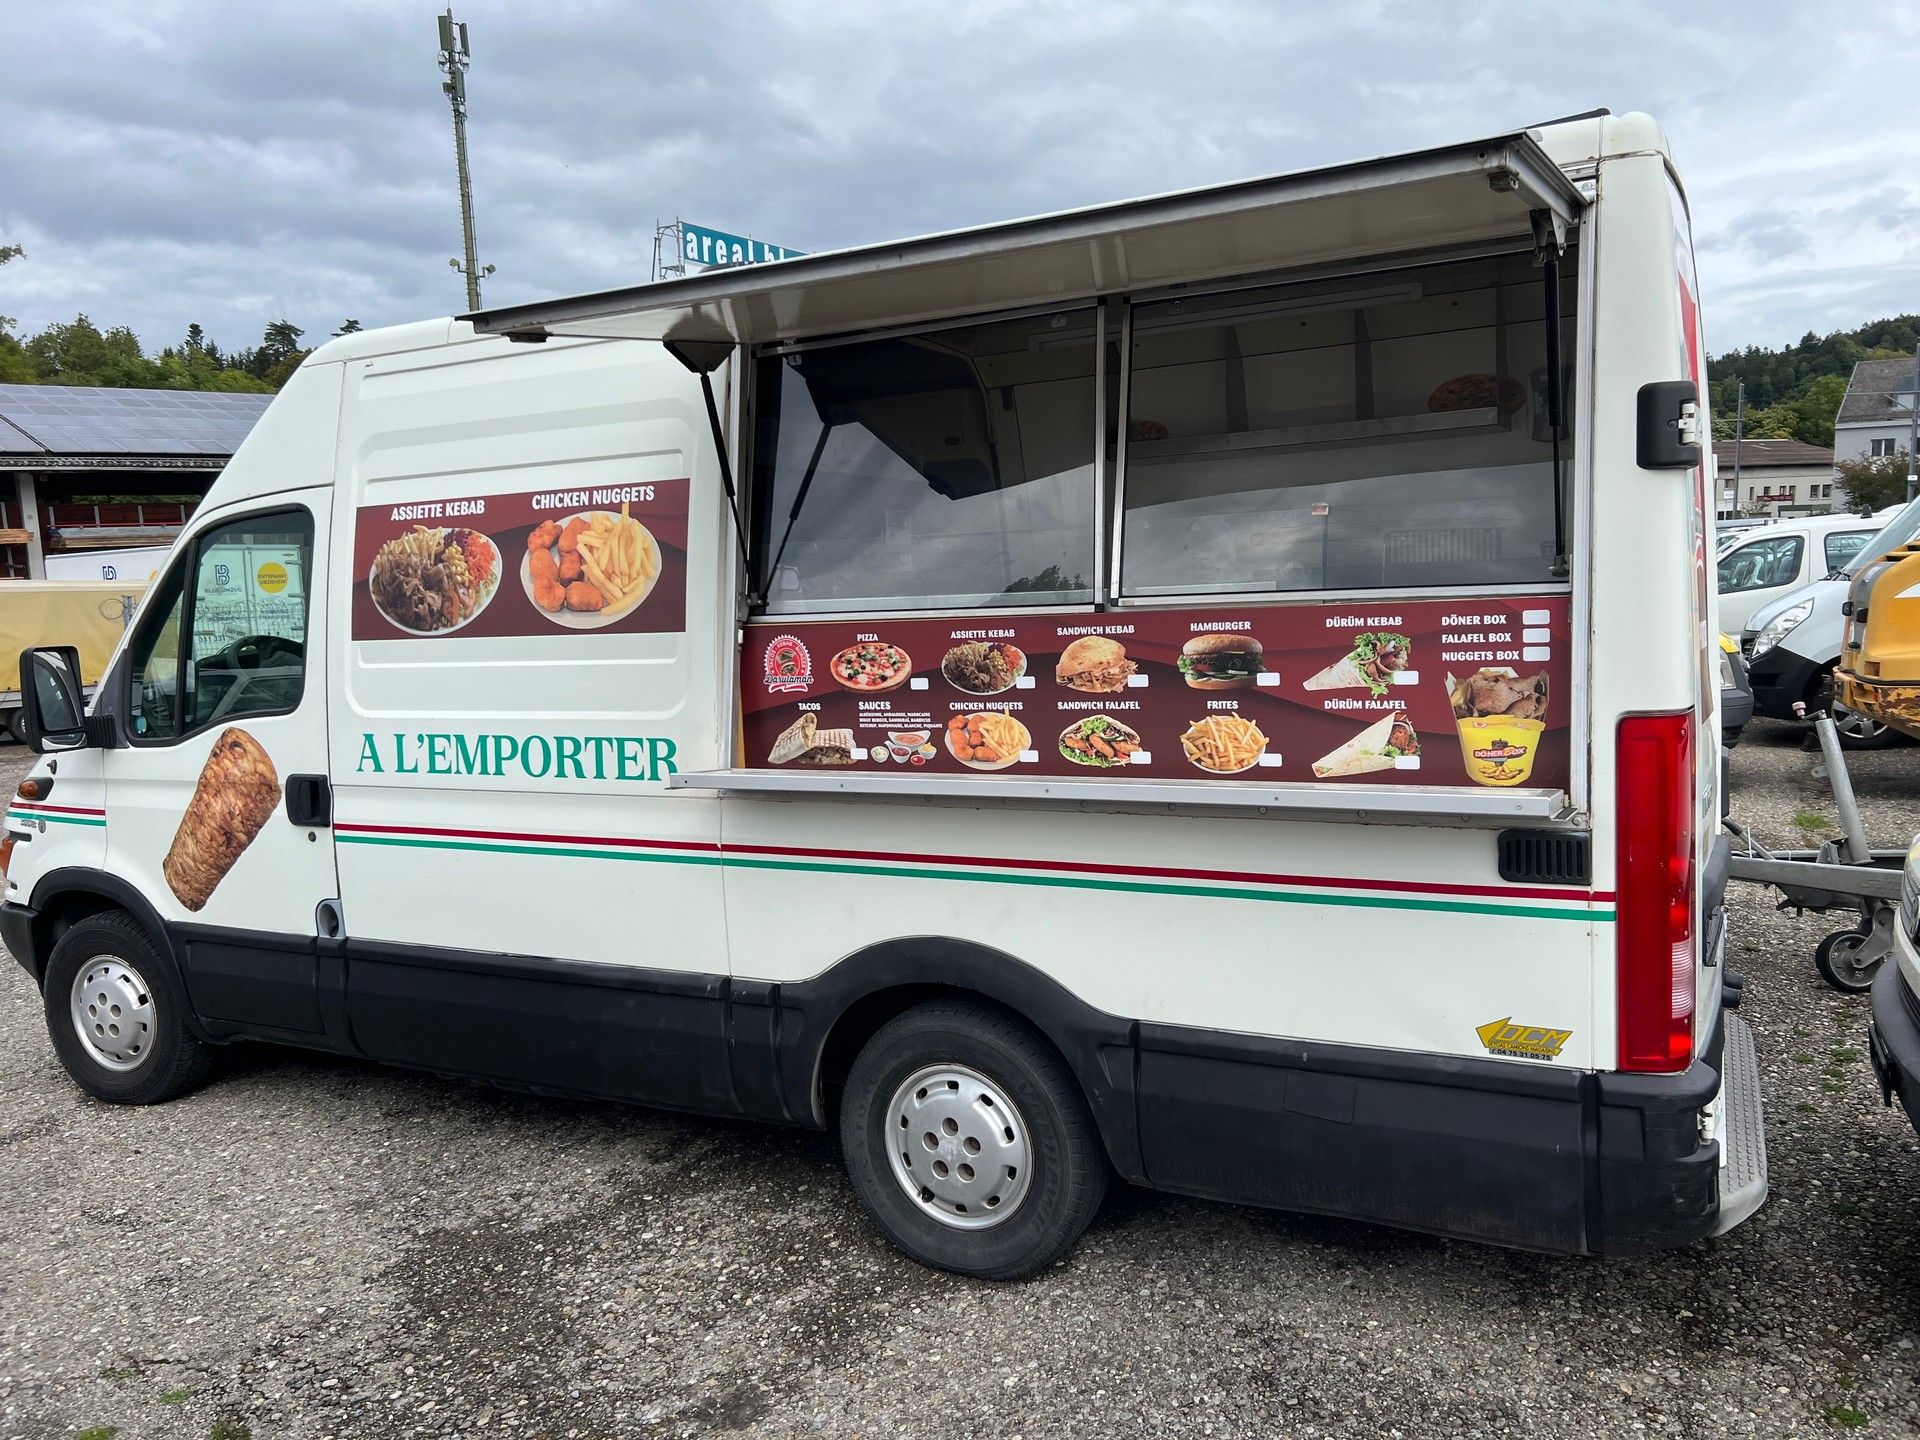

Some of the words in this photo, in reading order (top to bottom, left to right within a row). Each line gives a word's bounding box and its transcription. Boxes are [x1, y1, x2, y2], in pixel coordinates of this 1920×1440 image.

[686, 231, 754, 266] areal
[532, 491, 589, 510] CHICKEN
[592, 485, 655, 504] NUGGETS
[391, 503, 443, 521] ASSIETTE
[445, 500, 485, 517] KEBAB
[1325, 616, 1364, 628] DÜRÜM
[1366, 616, 1403, 626] KEBAB
[1441, 613, 1481, 626] DÖNER
[1483, 614, 1507, 625] BOX
[1056, 625, 1104, 636] SANDWICH
[1105, 624, 1135, 634] KEBAB
[1190, 621, 1252, 632] HAMBURGER
[856, 633, 879, 642] PIZZA
[950, 629, 986, 639] ASSIETTE
[988, 628, 1016, 638] KEBAB
[1441, 632, 1486, 644] FALAFEL
[1488, 632, 1512, 643] BOX
[776, 640, 793, 649] KEBAB
[1441, 651, 1494, 662] NUGGETS
[1498, 650, 1520, 661] BOX
[764, 673, 814, 684] Darulaman
[798, 702, 821, 711] TACOS
[858, 701, 891, 710] SAUCES
[949, 702, 985, 711] CHICKEN
[986, 701, 1024, 711] NUGGETS
[1057, 701, 1104, 710] SANDWICH
[1105, 701, 1141, 710] FALAFEL
[1206, 700, 1239, 710] FRITES
[1324, 699, 1363, 710] DÜRÜM
[1365, 700, 1407, 710] FALAFEL
[357, 734, 385, 772] A
[393, 734, 678, 781] L'EMPORTER
[1495, 1025, 1571, 1048] DCM
